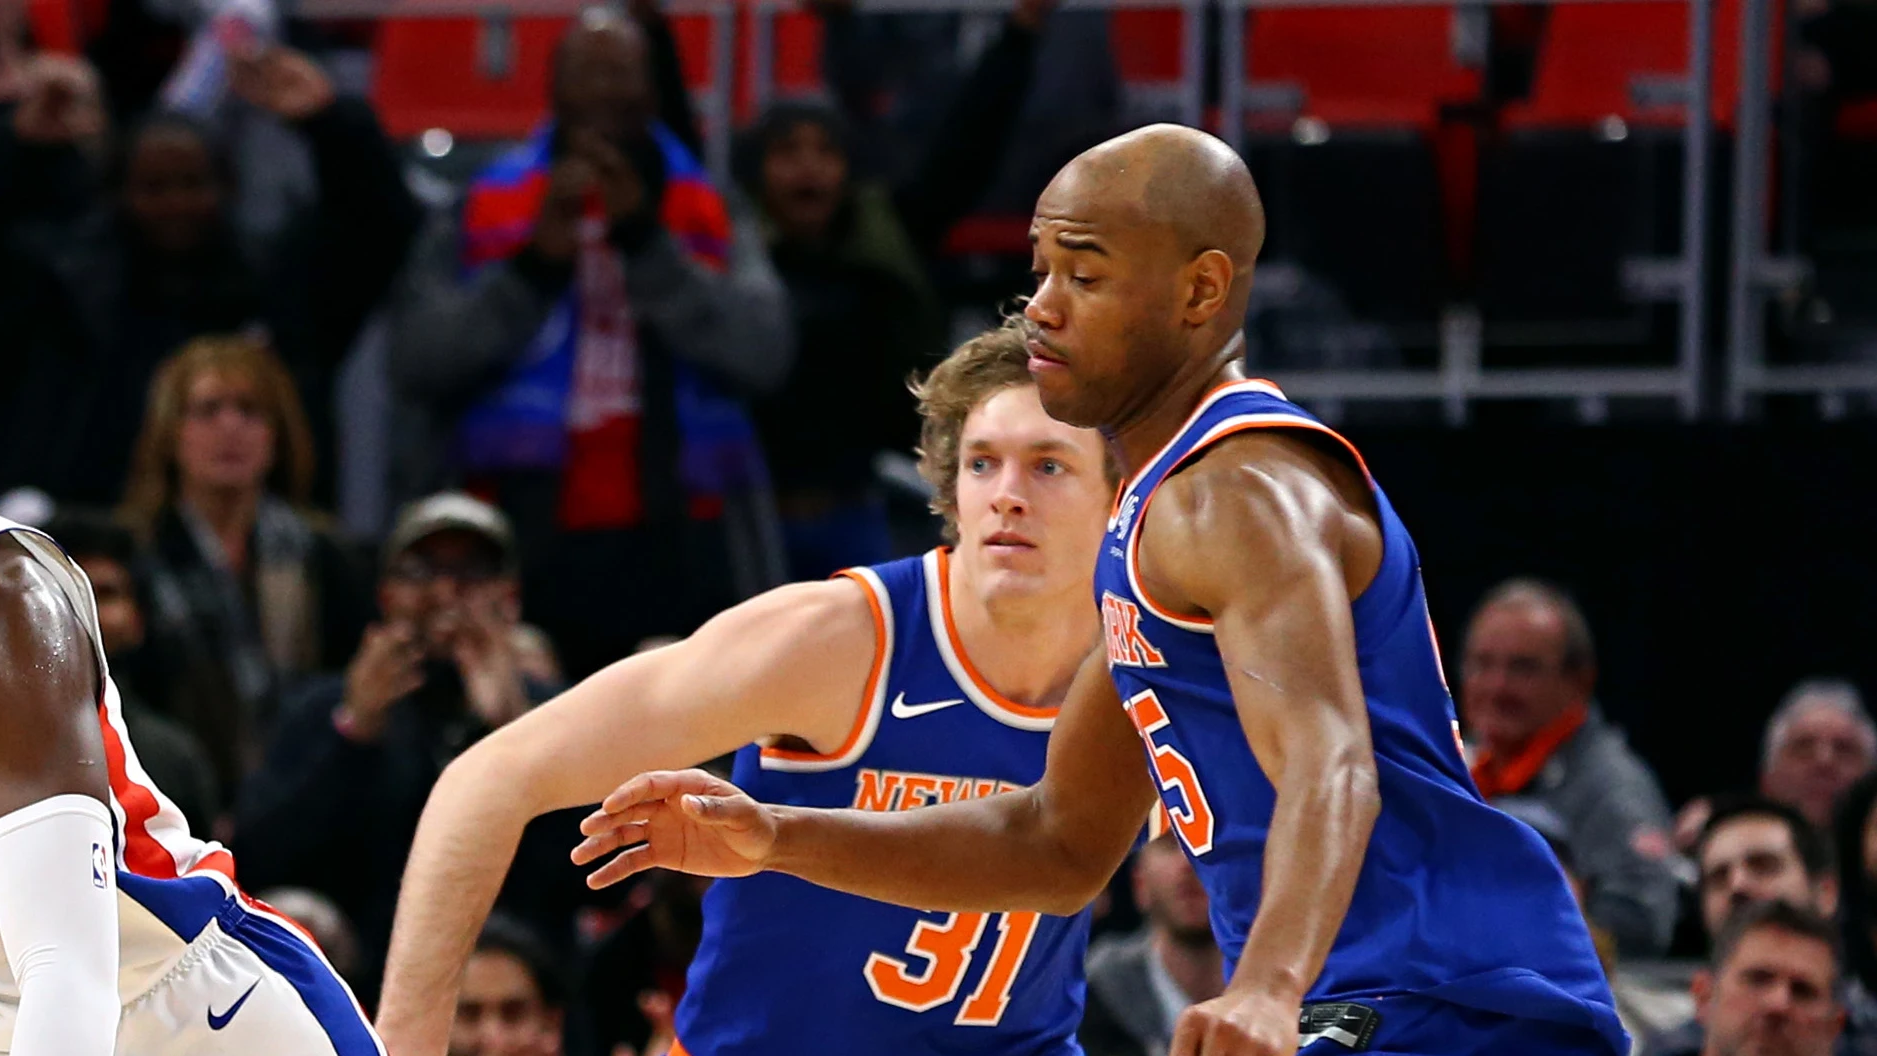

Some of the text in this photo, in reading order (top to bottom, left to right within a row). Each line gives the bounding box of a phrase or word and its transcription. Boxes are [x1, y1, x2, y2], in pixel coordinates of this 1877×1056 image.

[1101, 590, 1168, 672] RK
[1122, 687, 1215, 858] 5
[862, 911, 1042, 1027] 31
